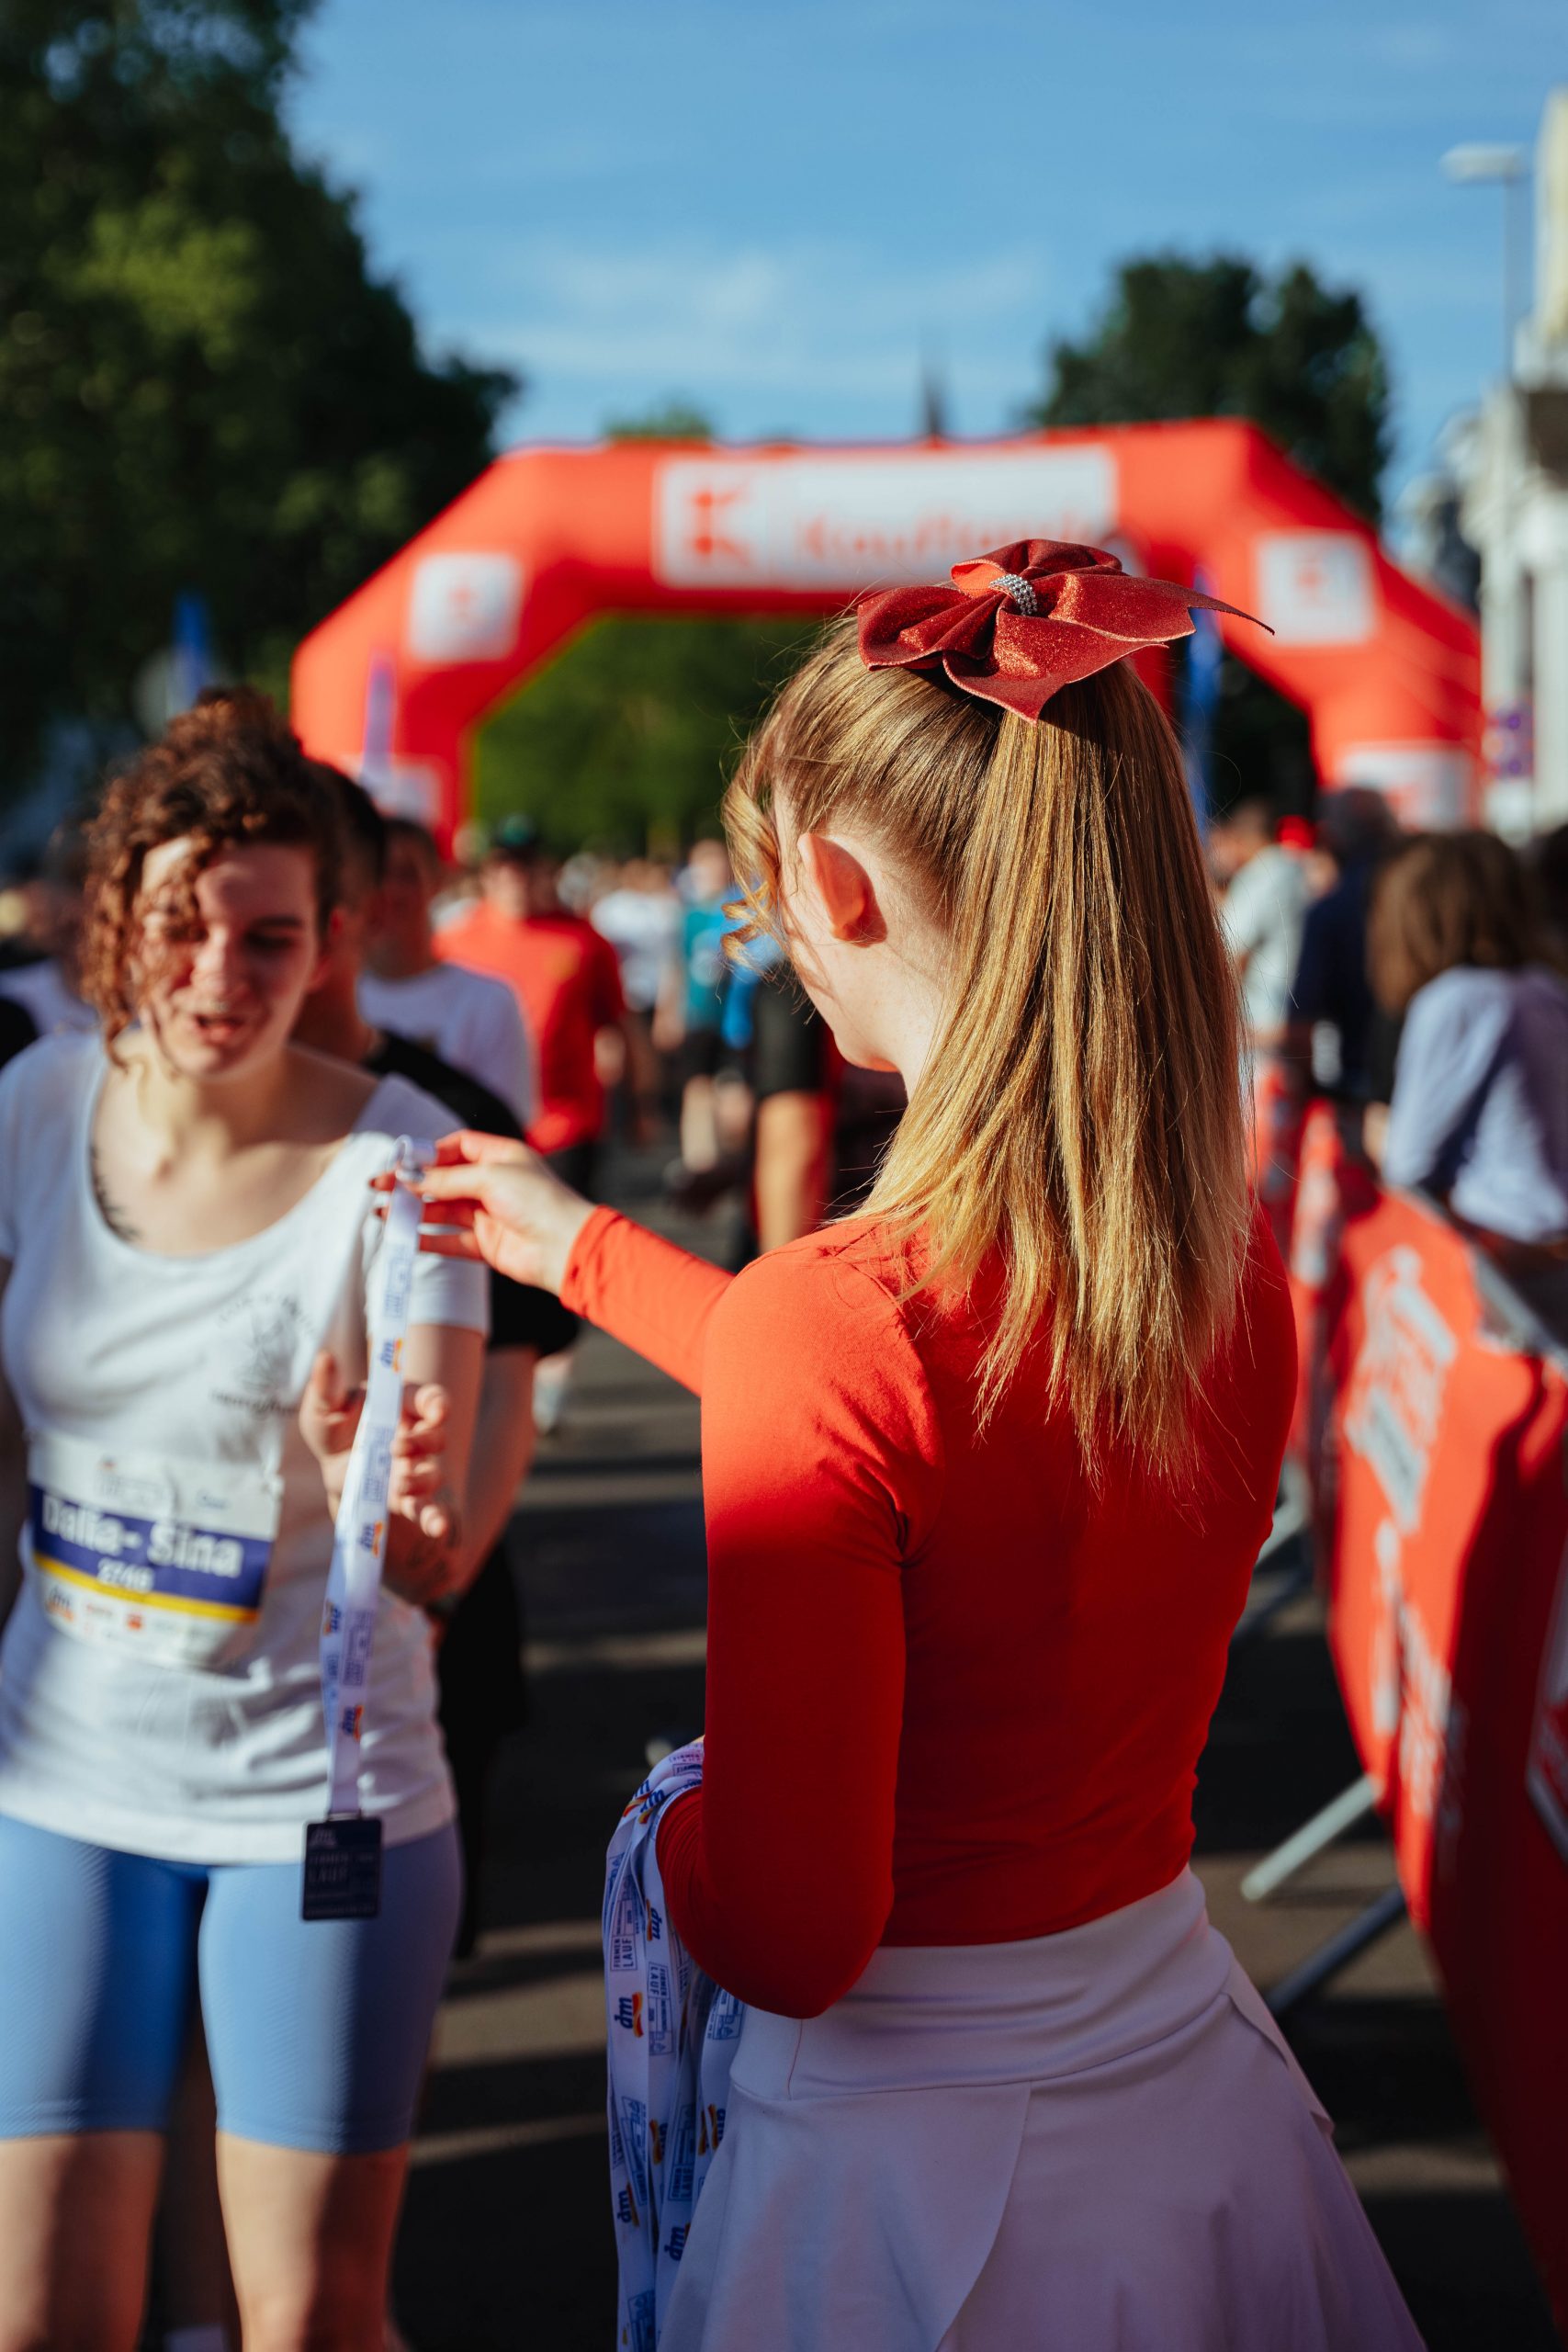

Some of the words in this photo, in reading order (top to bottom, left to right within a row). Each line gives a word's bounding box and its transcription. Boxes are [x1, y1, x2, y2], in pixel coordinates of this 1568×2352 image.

[622, 1939, 634, 1968] LAUF
[649, 1966, 660, 1996] LAUF
[660, 1968, 668, 1996] FIRMEN
[615, 1996, 634, 2030] dm
[617, 2189, 633, 2223] dm
[664, 2226, 683, 2262] dm
